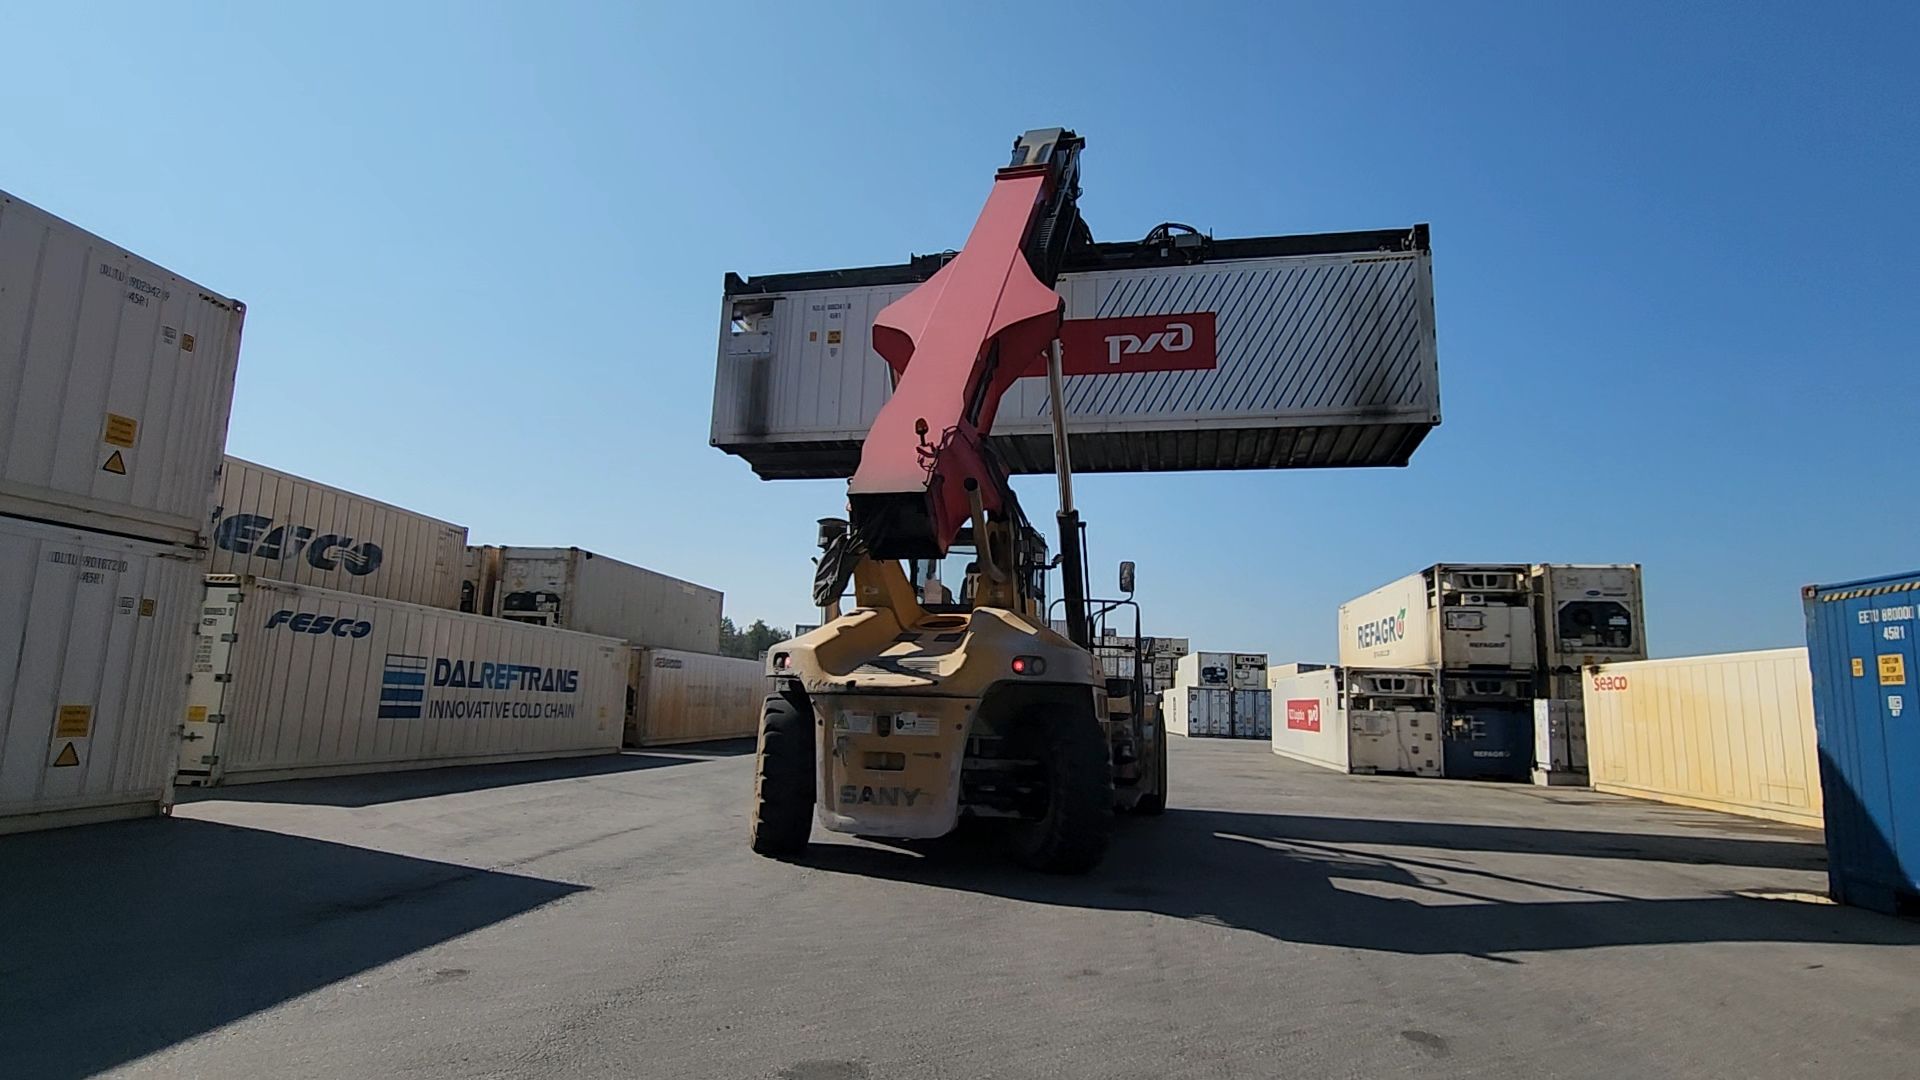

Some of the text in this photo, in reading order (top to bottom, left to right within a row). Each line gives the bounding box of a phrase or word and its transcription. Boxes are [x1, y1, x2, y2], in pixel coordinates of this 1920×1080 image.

[264, 610, 371, 638] FESCO
[1357, 613, 1405, 650] REFAGRO
[432, 657, 579, 693] DALREFTRANS
[1593, 675, 1628, 692] seaco
[428, 700, 576, 720] INNOVATIVE COLD CHAIN
[840, 784, 922, 807] SANY
